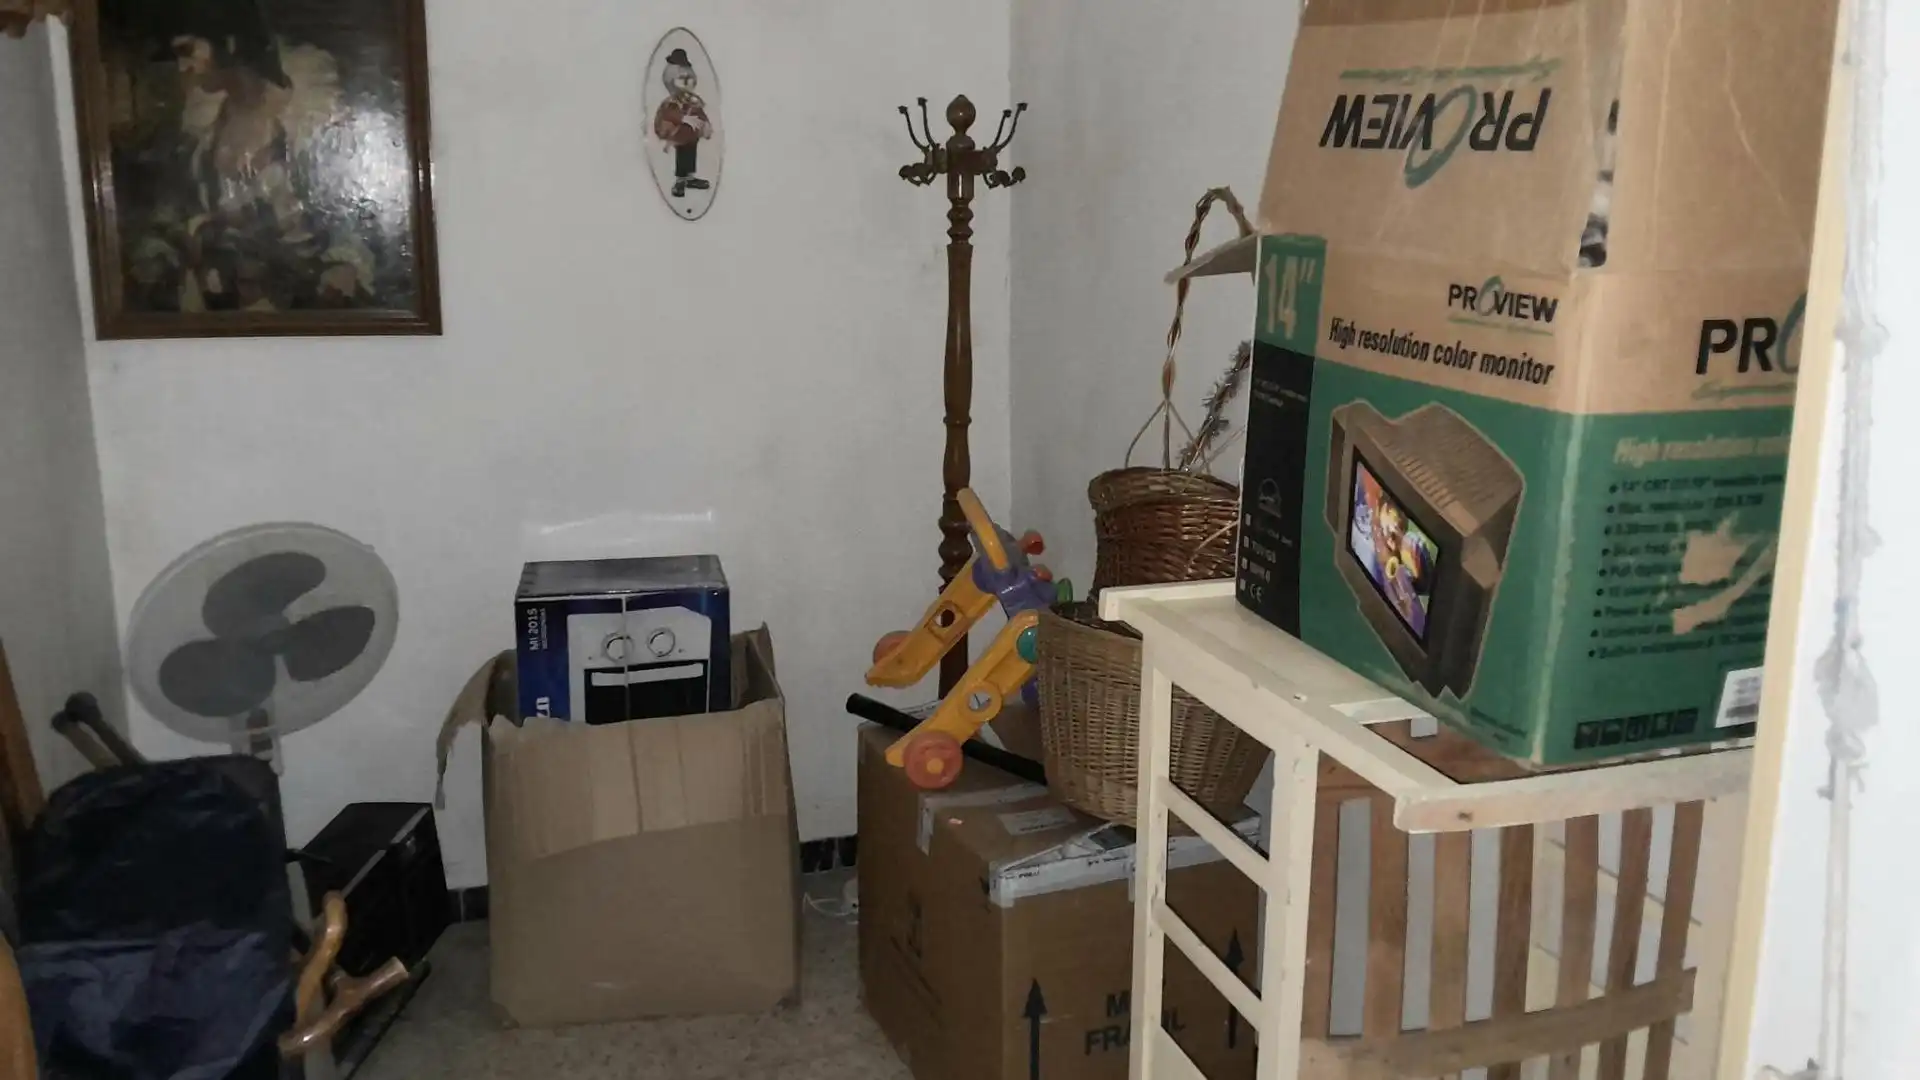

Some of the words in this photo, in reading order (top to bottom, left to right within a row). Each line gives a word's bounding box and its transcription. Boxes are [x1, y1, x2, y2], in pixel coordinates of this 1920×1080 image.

[1319, 84, 1552, 189] PROVIEW
[1265, 253, 1316, 340] 14"
[1447, 275, 1559, 323] PROVIEW
[1329, 317, 1356, 349] High
[1356, 328, 1431, 363] resolution
[1432, 340, 1478, 371] color
[1479, 352, 1556, 386] monitor
